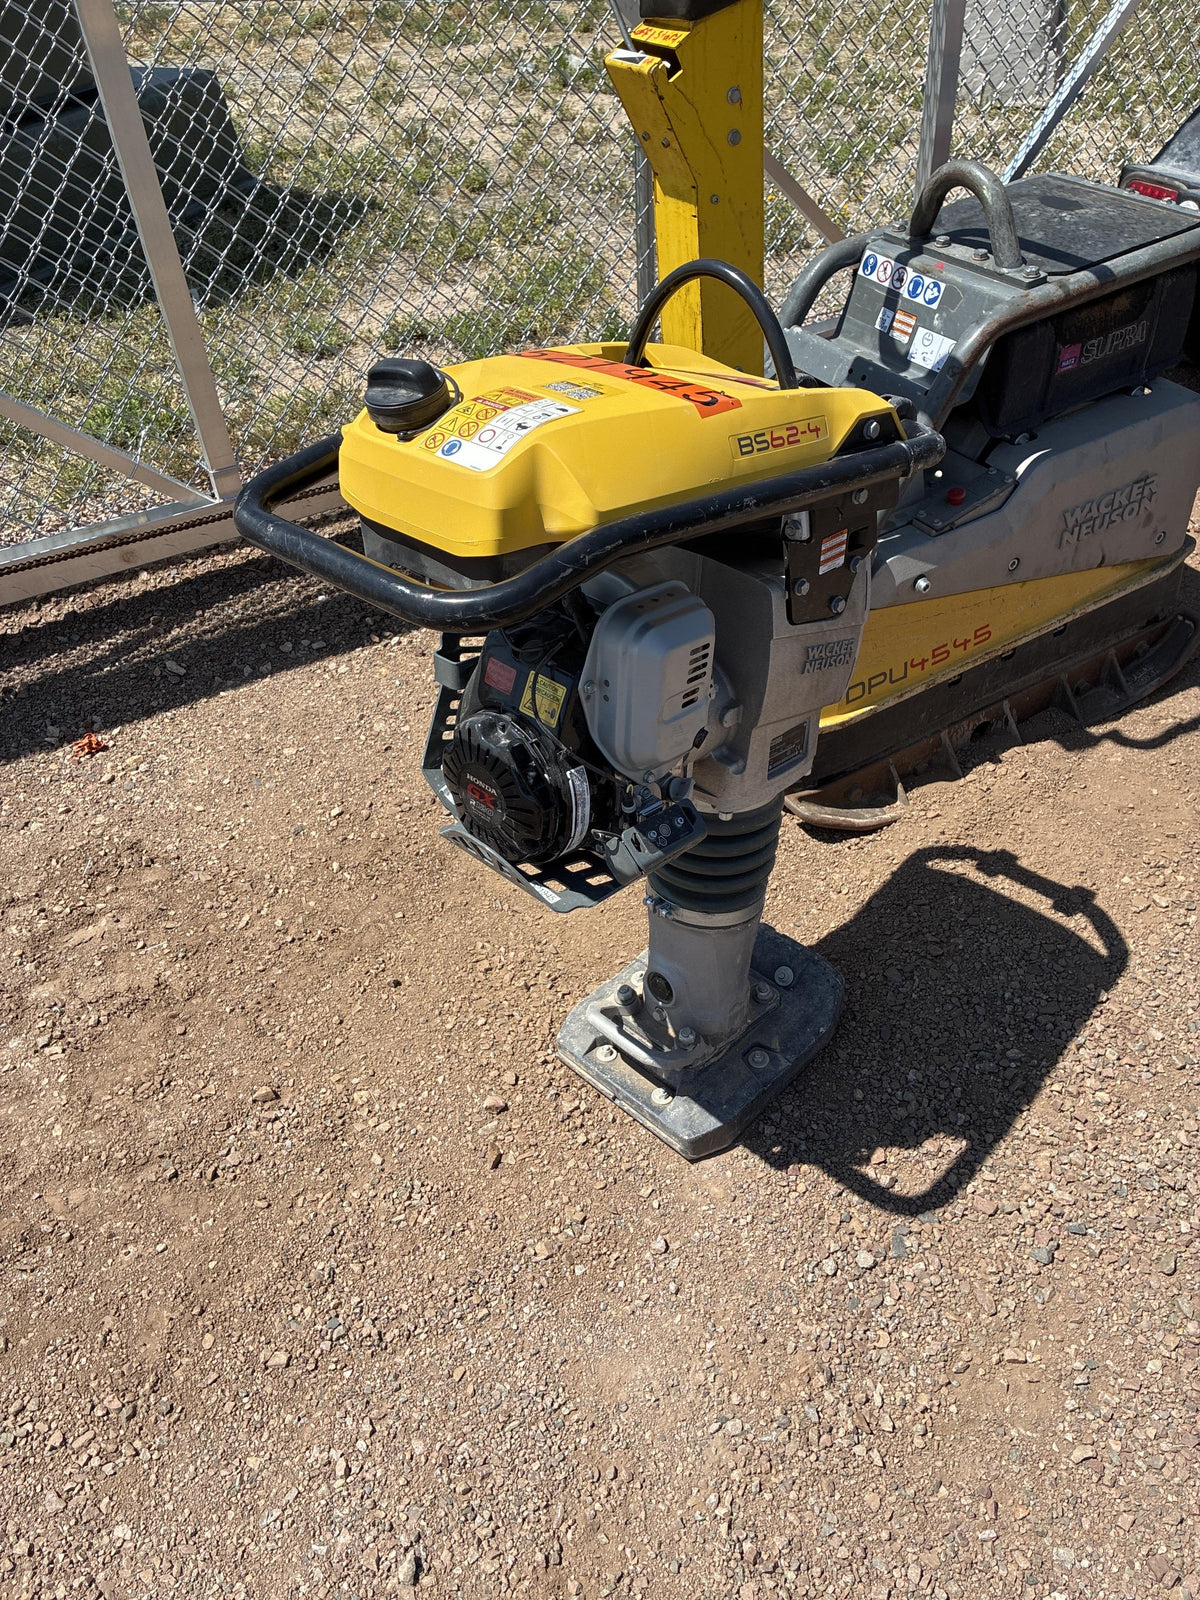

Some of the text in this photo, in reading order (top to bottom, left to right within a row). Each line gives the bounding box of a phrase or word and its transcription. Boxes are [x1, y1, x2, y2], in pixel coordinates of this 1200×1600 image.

[1081, 320, 1147, 364] SUPRA
[737, 422, 821, 456] BS62-4
[1062, 472, 1158, 530] WACKER
[1058, 497, 1153, 550] NEUSON
[801, 653, 855, 674] NEUSON
[806, 638, 855, 660] WACKER
[846, 623, 992, 705] DPU4545
[466, 773, 497, 796] HONDA
[467, 784, 496, 809] GX
